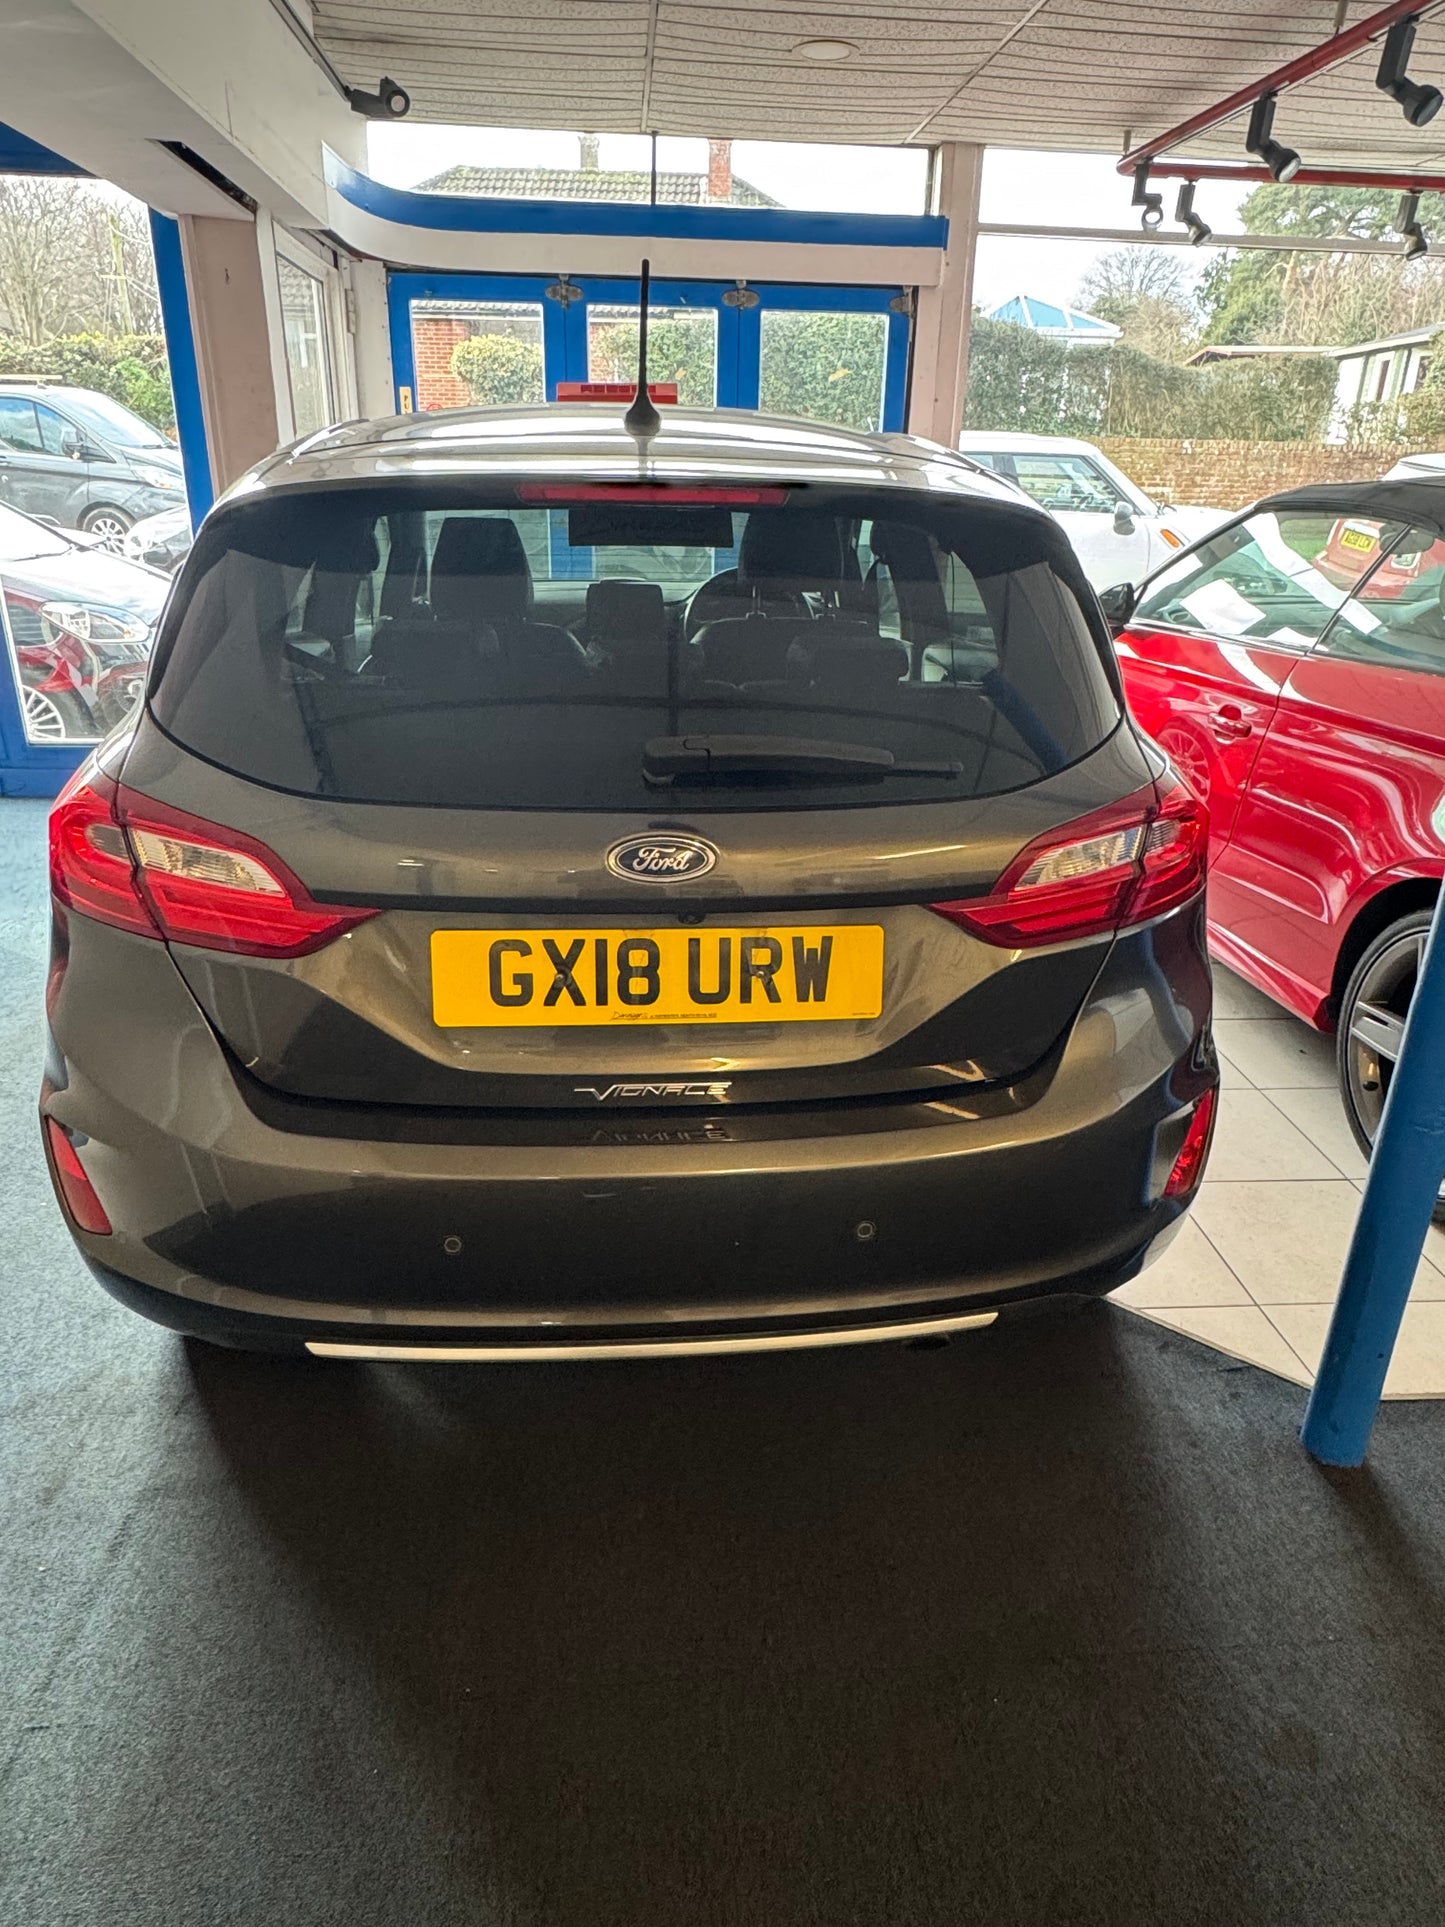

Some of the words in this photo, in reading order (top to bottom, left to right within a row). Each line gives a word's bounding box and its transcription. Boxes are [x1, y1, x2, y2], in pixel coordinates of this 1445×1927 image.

[632, 846, 694, 871] Ford
[488, 937, 660, 1008] GX18
[687, 935, 833, 1005] URW
[574, 1081, 732, 1102] VIGNALE
